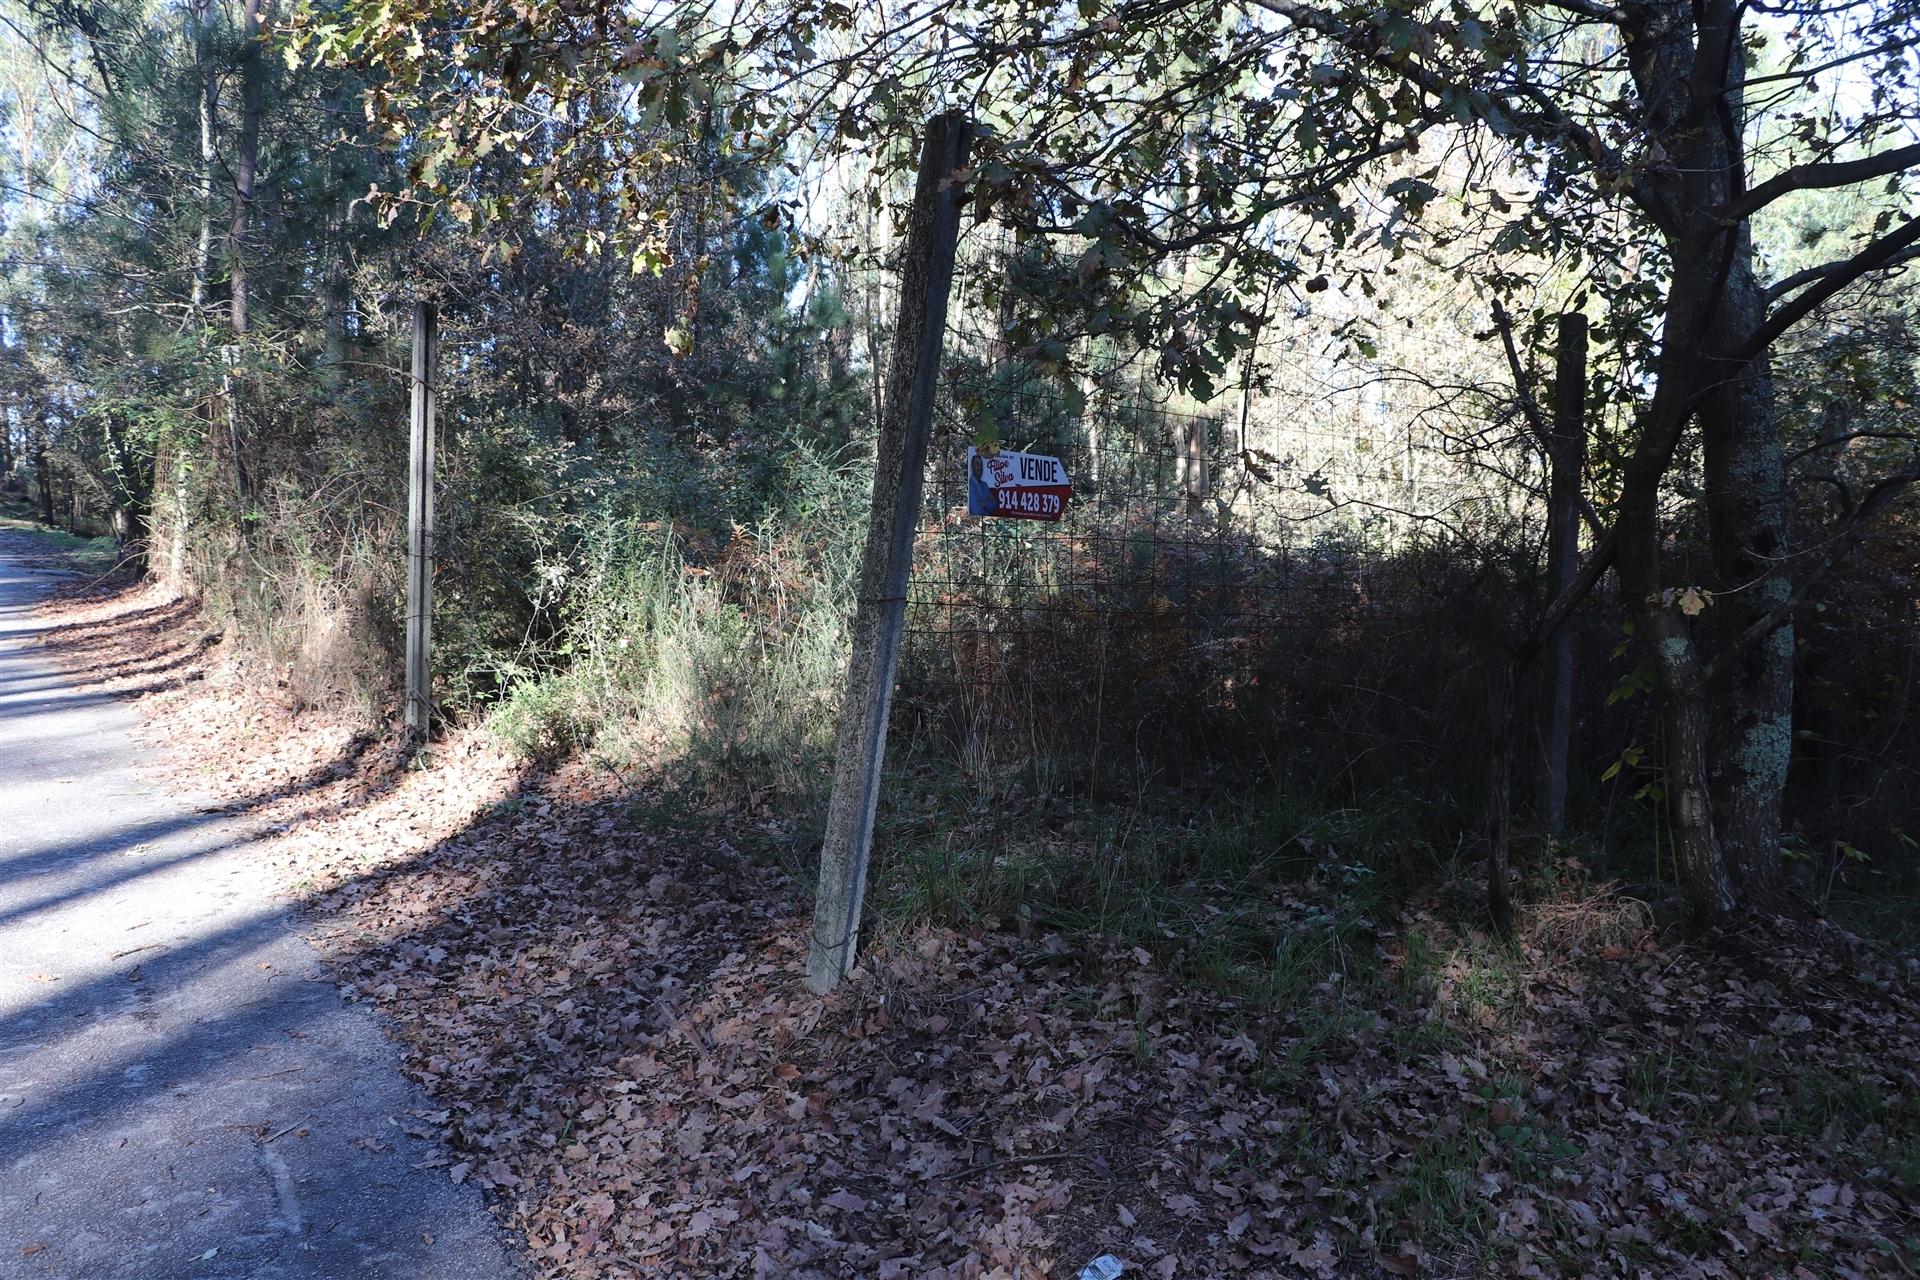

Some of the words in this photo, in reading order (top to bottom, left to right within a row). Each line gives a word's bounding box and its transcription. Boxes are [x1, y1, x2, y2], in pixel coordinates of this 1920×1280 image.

[987, 459, 1009, 474] Filipe
[1020, 457, 1058, 483] VENDE
[994, 471, 1014, 487] Silva
[998, 489, 1019, 510] 914
[1020, 492, 1040, 512] 428
[1042, 494, 1060, 514] 379
